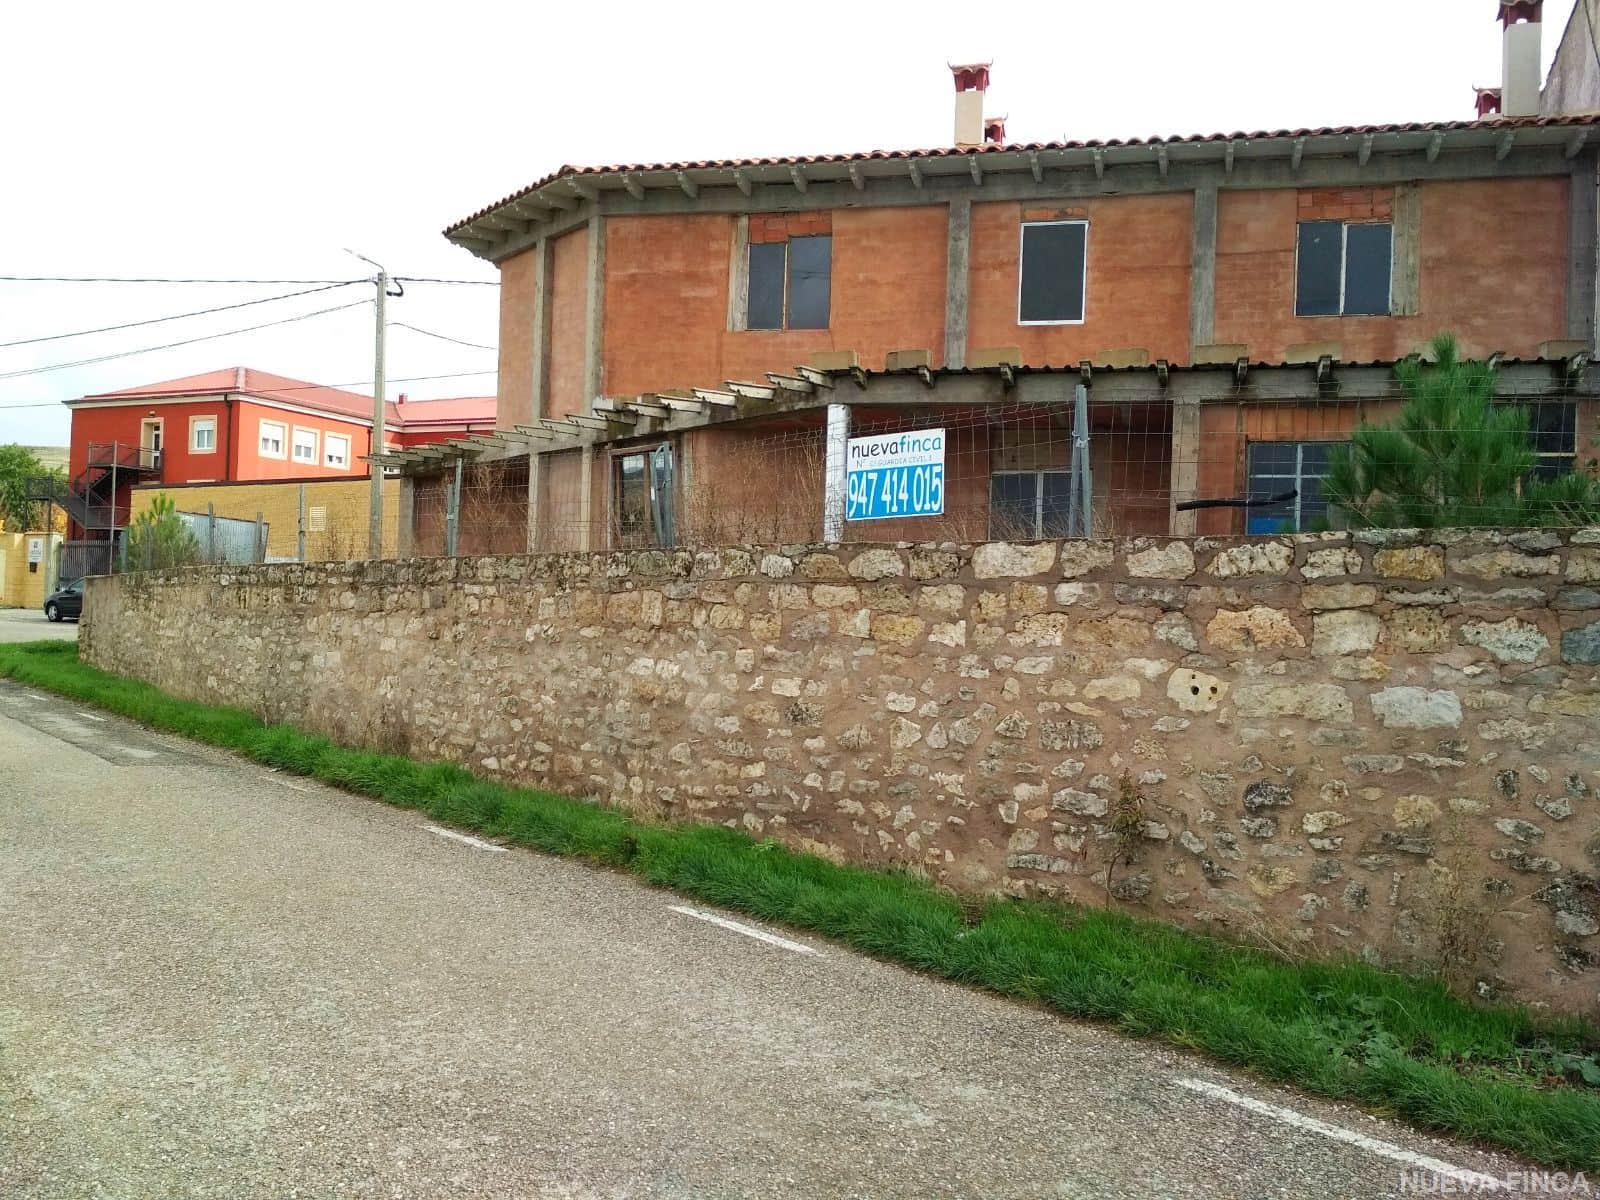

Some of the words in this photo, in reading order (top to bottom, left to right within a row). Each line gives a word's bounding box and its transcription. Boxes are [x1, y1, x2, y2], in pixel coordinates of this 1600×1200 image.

[852, 435, 942, 458] nuevafinca
[849, 472, 878, 518] 947
[881, 468, 909, 514] 414
[913, 465, 942, 512] 015
